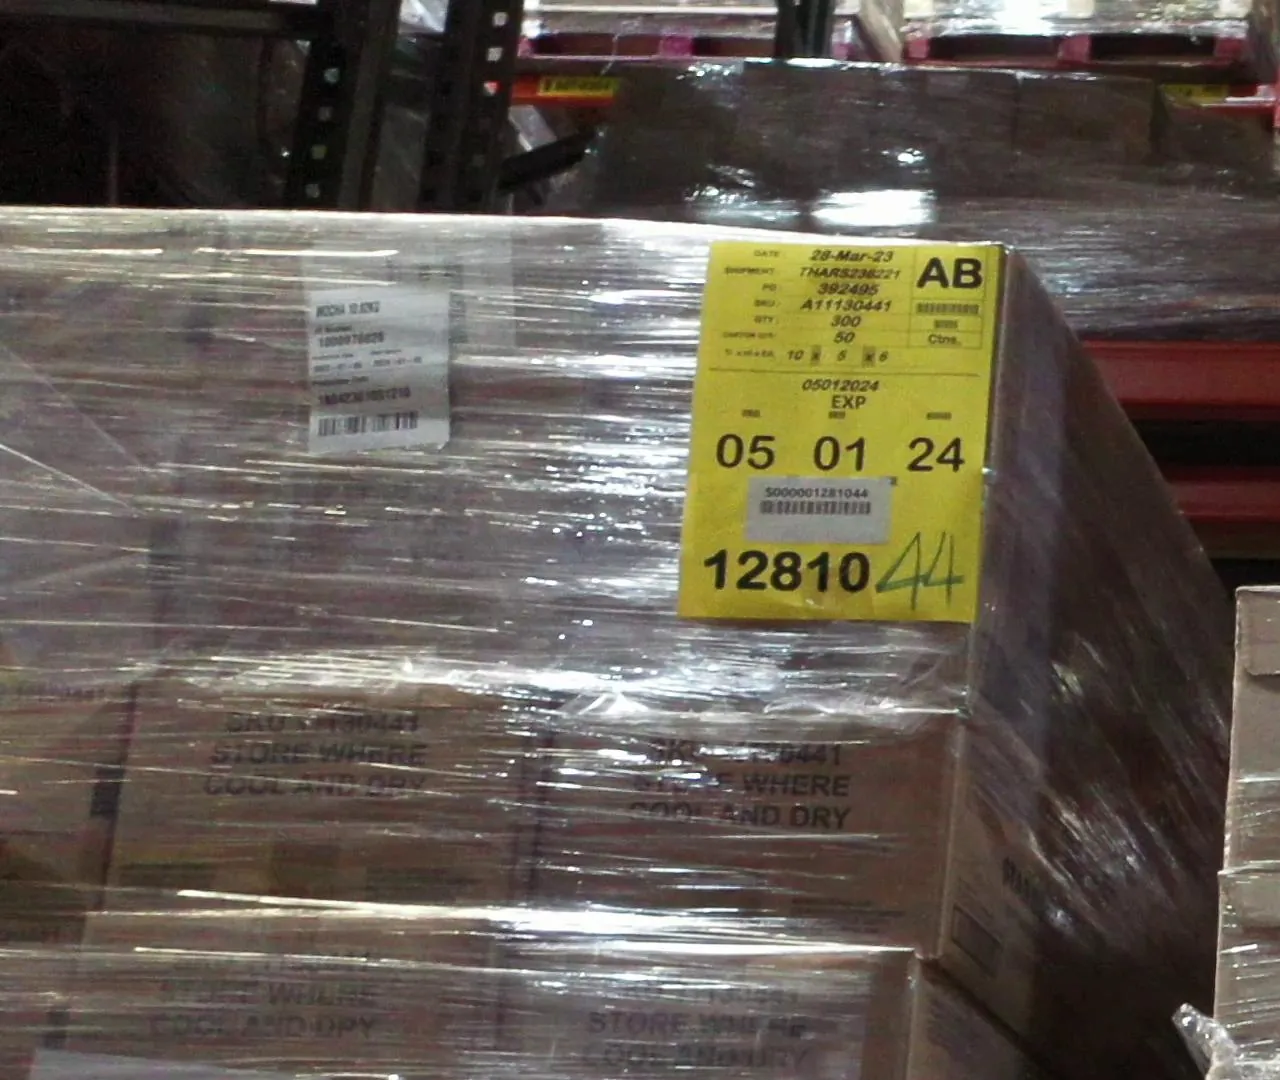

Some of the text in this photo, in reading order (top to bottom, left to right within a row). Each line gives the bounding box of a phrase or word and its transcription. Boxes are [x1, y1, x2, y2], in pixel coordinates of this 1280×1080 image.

[810, 249, 895, 263] 28-Mar-23
[916, 257, 983, 289] AB
[830, 315, 863, 328] 300
[833, 331, 856, 344] 50
[801, 378, 880, 392] 05012024
[831, 395, 867, 410] EXP
[716, 433, 966, 473] 05 01 24
[704, 549, 871, 593] 12810
[743, 774, 851, 797] WHERE
[789, 806, 851, 830] DRY
